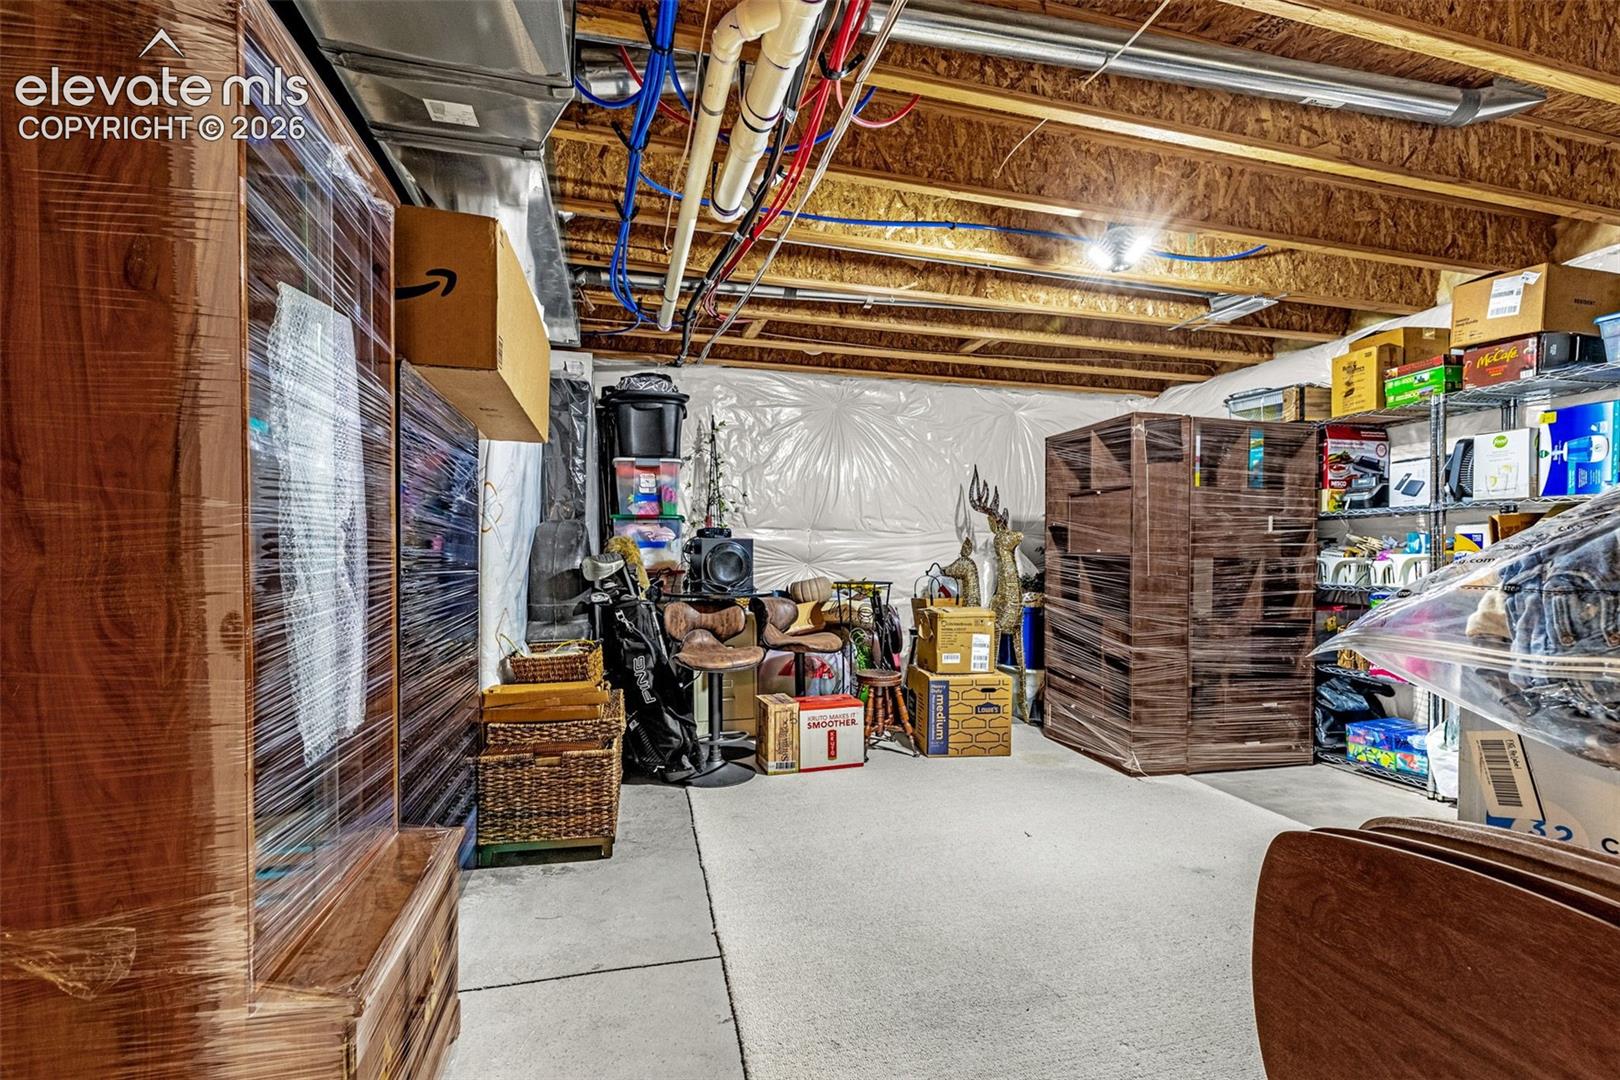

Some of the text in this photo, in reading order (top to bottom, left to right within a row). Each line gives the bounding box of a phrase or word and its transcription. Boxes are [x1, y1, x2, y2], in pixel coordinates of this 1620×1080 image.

[632, 655, 656, 704] PING
[829, 712, 849, 720] MAKES
[936, 694, 946, 740] medium
